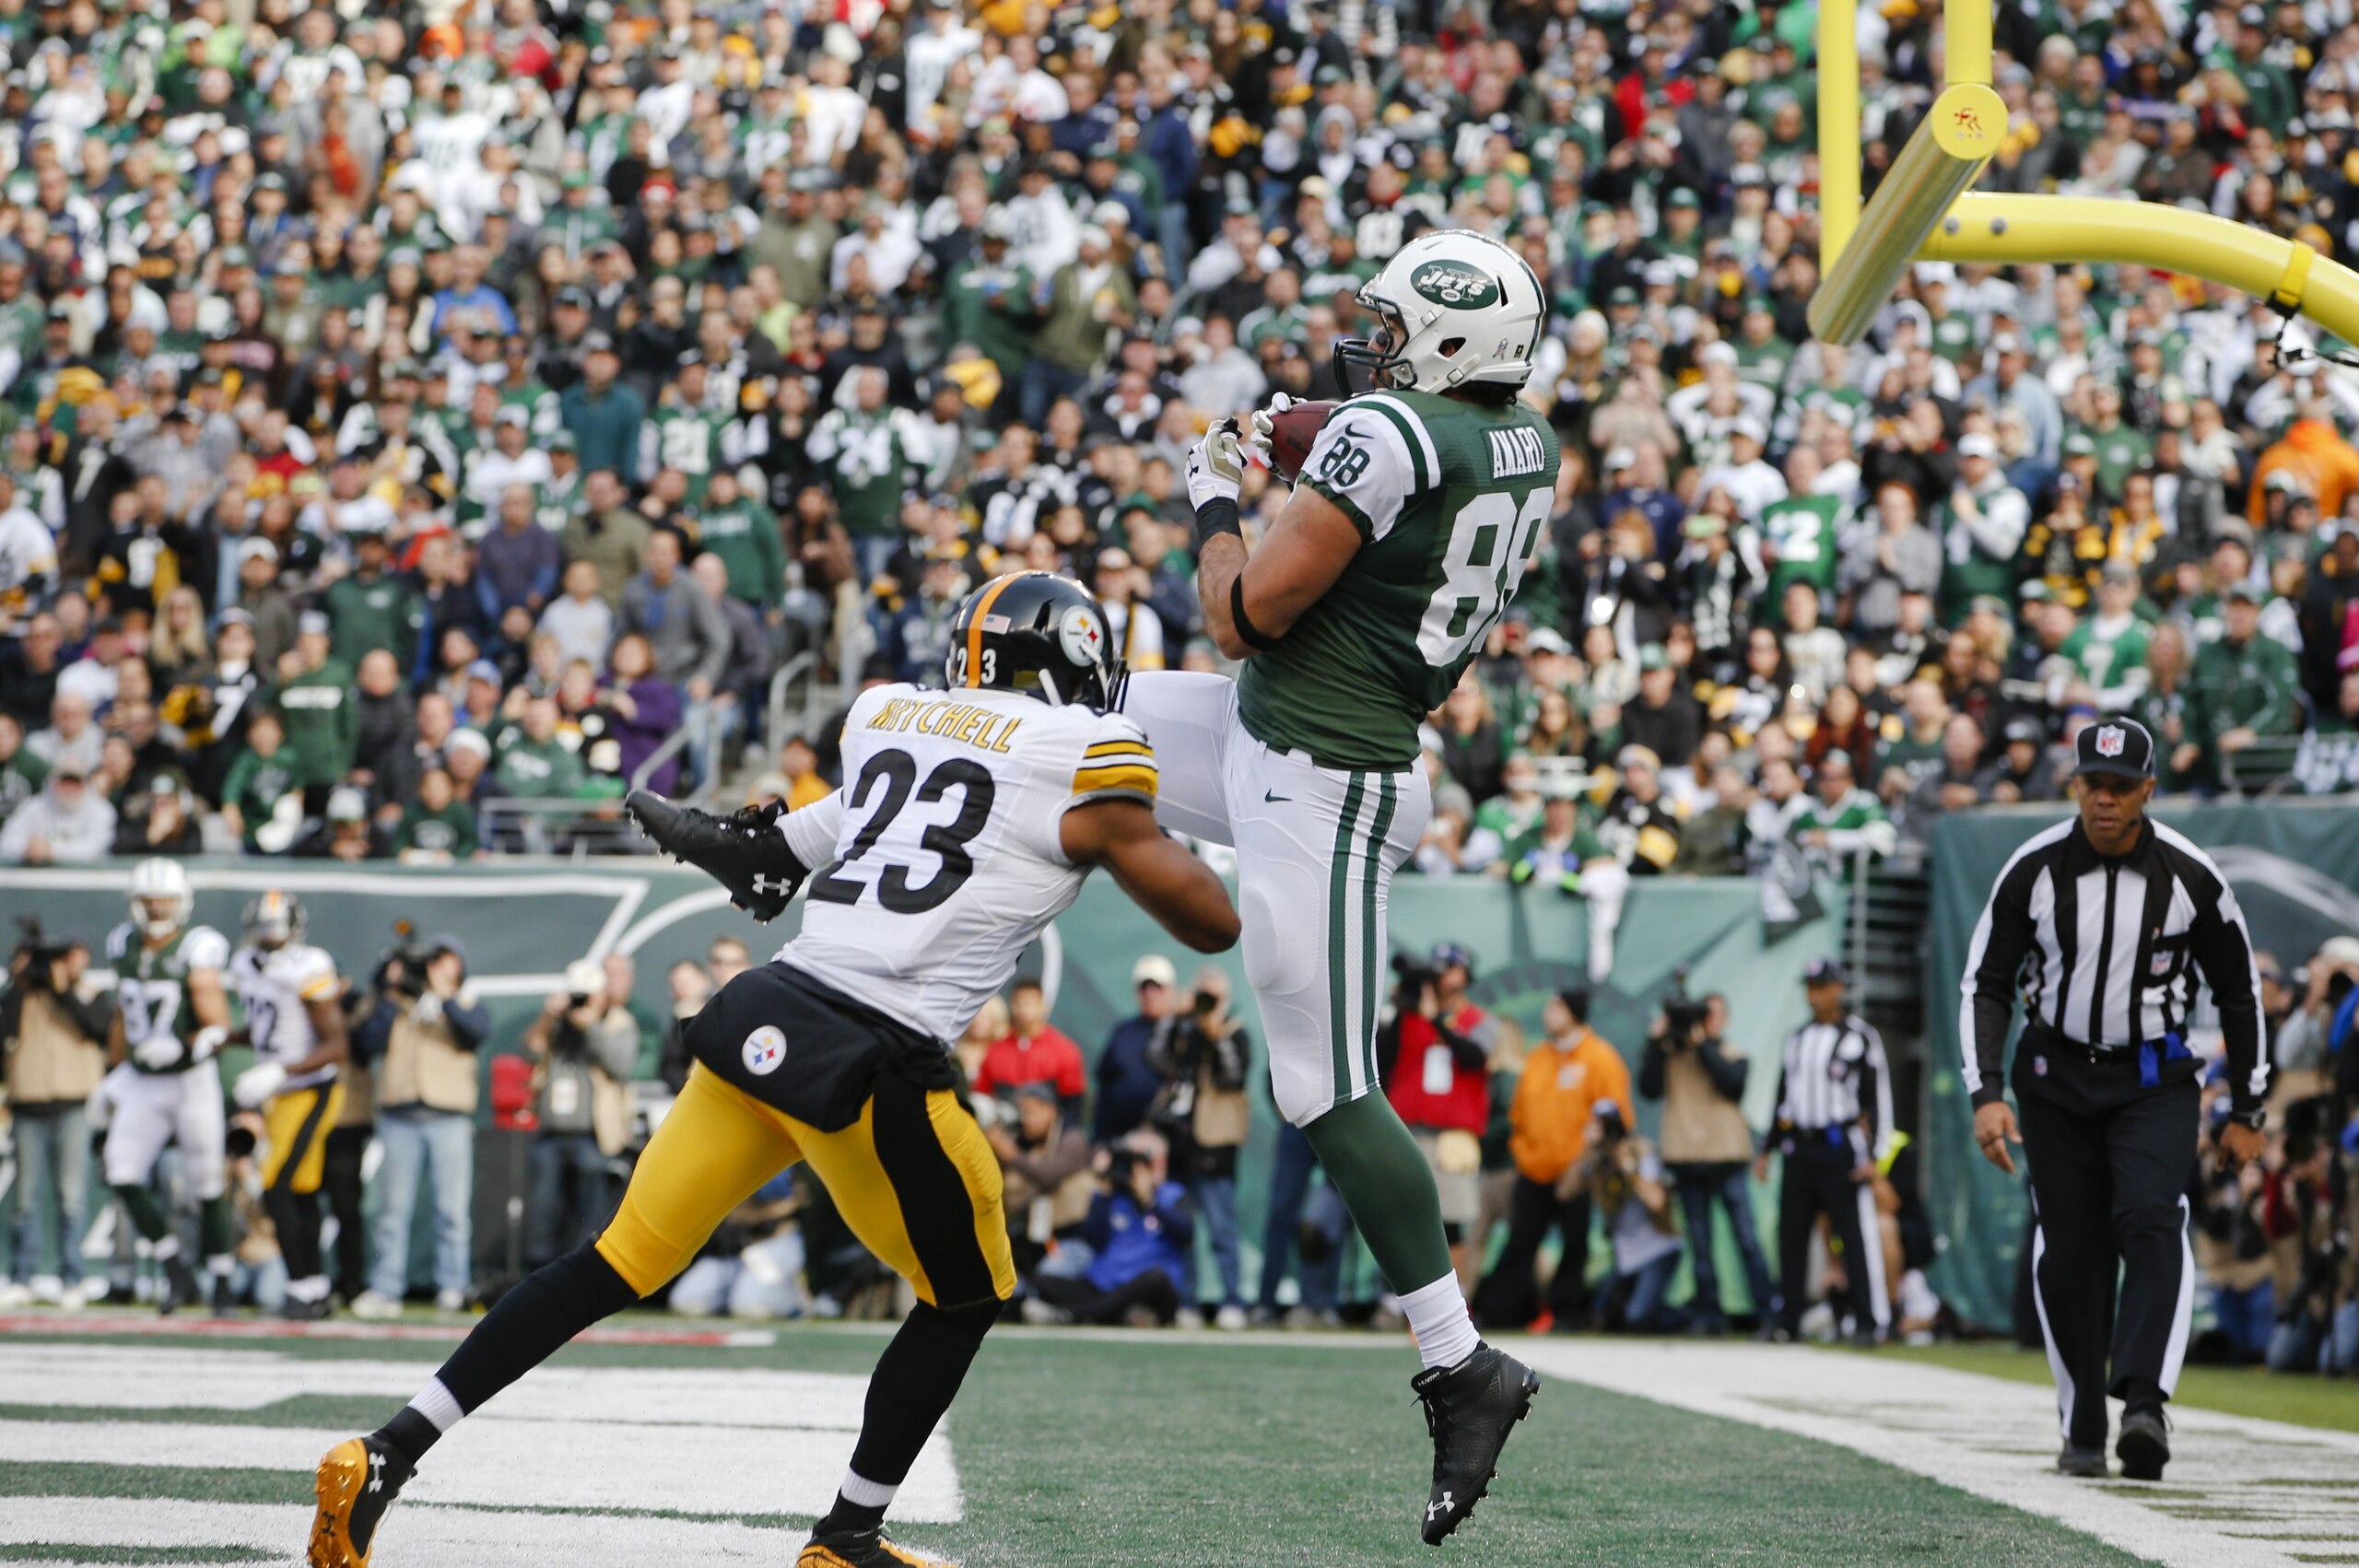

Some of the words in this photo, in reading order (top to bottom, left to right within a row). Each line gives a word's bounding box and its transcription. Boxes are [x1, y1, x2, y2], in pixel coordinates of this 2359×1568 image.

[1420, 271, 1486, 296] JETS
[1320, 436, 1370, 487] 88
[1415, 486, 1555, 668] 88
[957, 646, 997, 685] 23
[865, 697, 1023, 754] MITCHELL
[804, 747, 996, 915] 23
